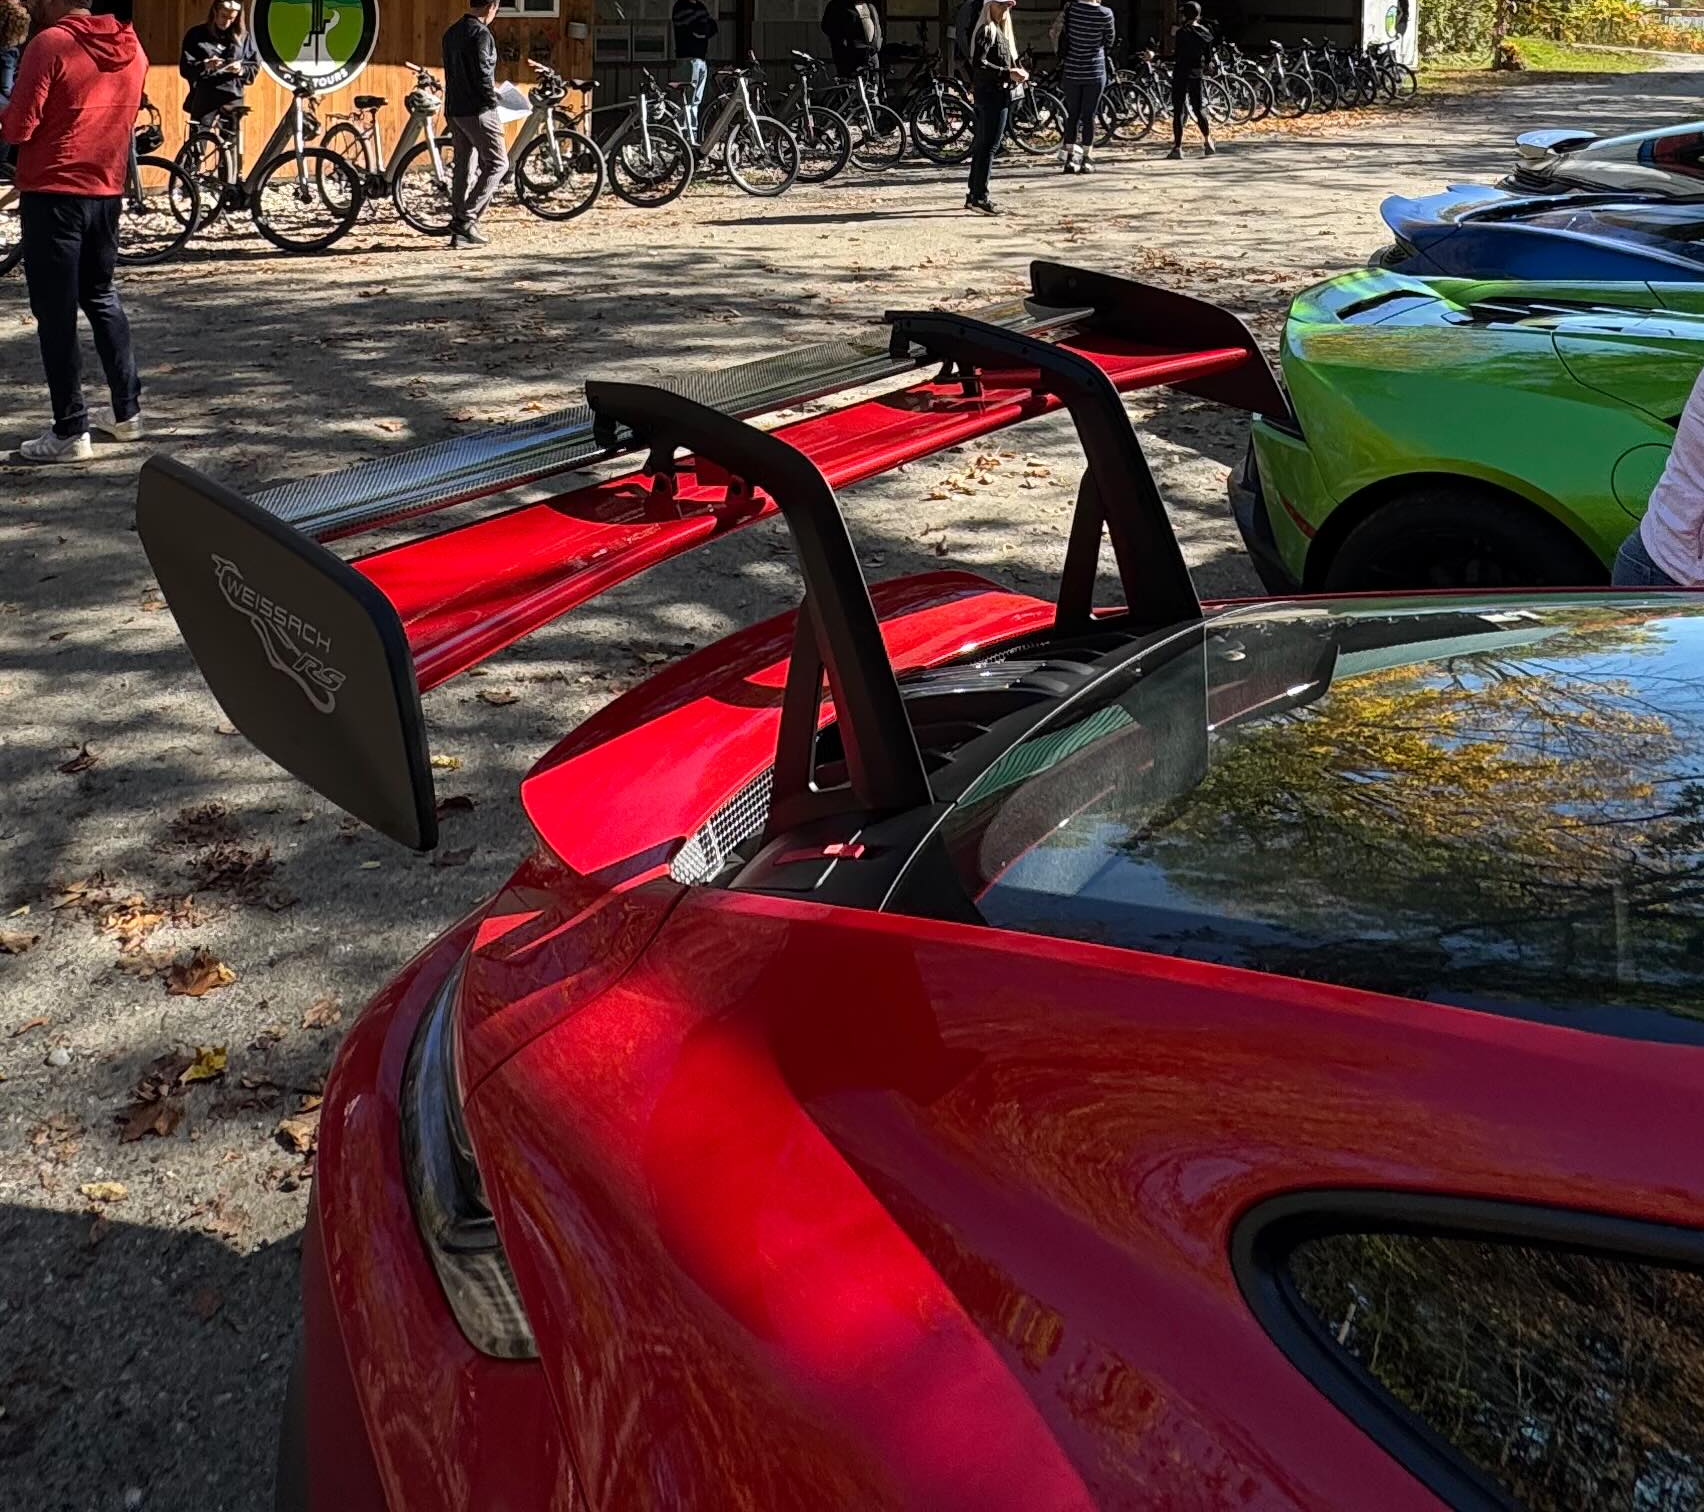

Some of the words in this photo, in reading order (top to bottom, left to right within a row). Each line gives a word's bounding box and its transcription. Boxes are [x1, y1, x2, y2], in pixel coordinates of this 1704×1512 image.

[311, 67, 349, 88] TOURS
[227, 575, 332, 653] WEISSACH
[292, 651, 346, 692] RS
